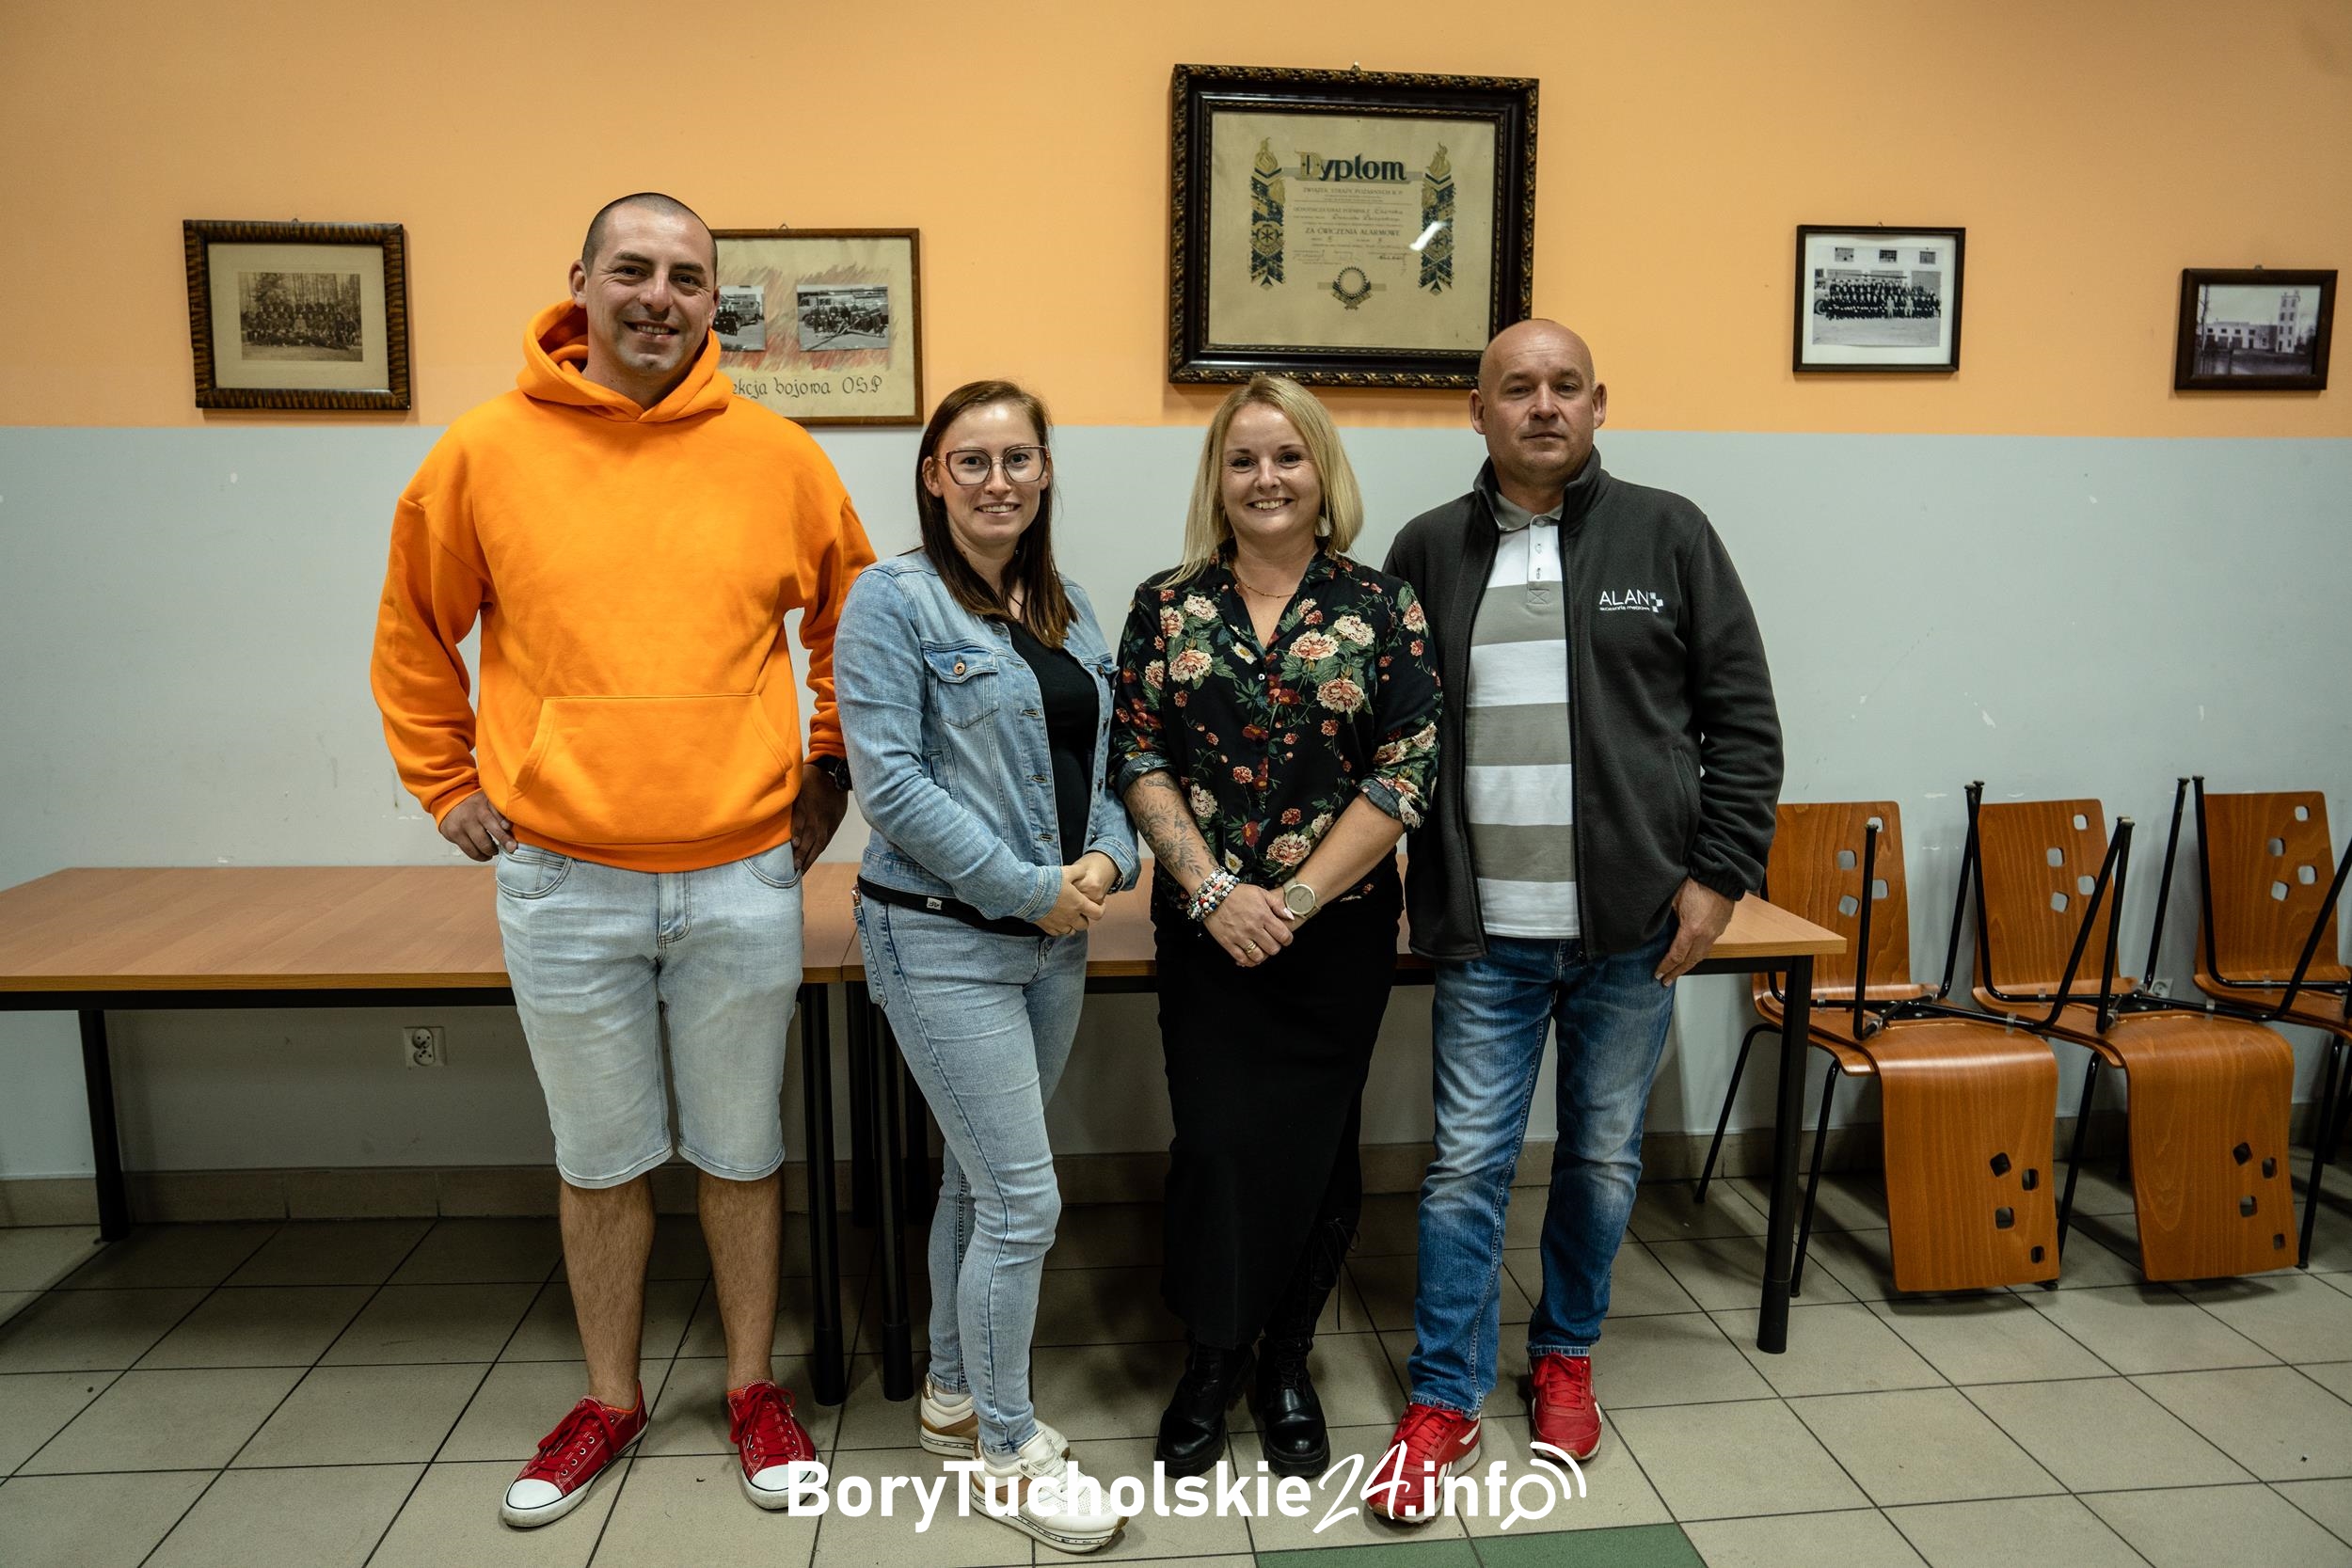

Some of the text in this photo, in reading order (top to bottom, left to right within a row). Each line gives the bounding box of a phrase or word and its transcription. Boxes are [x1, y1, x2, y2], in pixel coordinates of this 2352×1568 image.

[1296, 150, 1406, 182] Dyplom
[1360, 229, 1401, 237] ALARMOWE
[732, 375, 882, 399] ekcja bojowa OSP
[1599, 589, 1649, 605] ALAN
